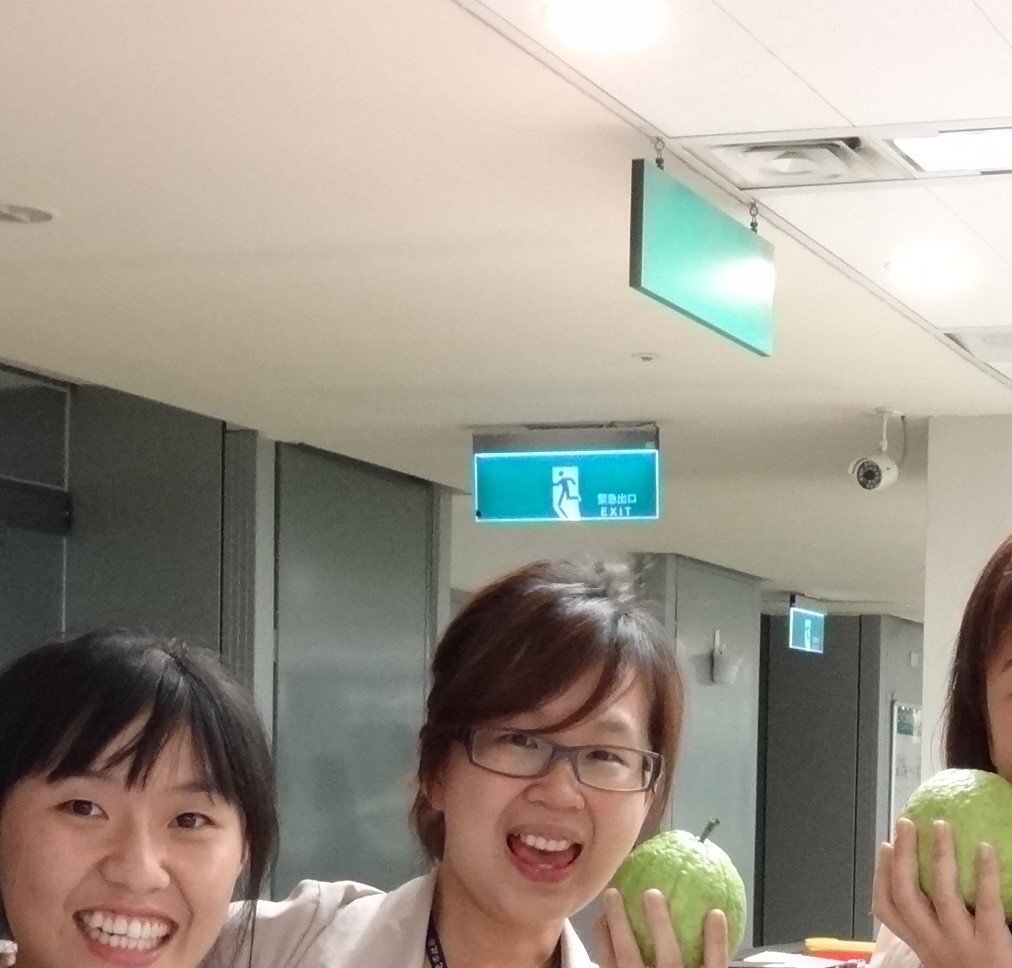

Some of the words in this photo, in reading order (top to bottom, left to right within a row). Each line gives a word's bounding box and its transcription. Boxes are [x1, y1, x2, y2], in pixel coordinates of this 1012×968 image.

[597, 493, 637, 505] 緊急出口
[600, 507, 632, 517] EXIT
